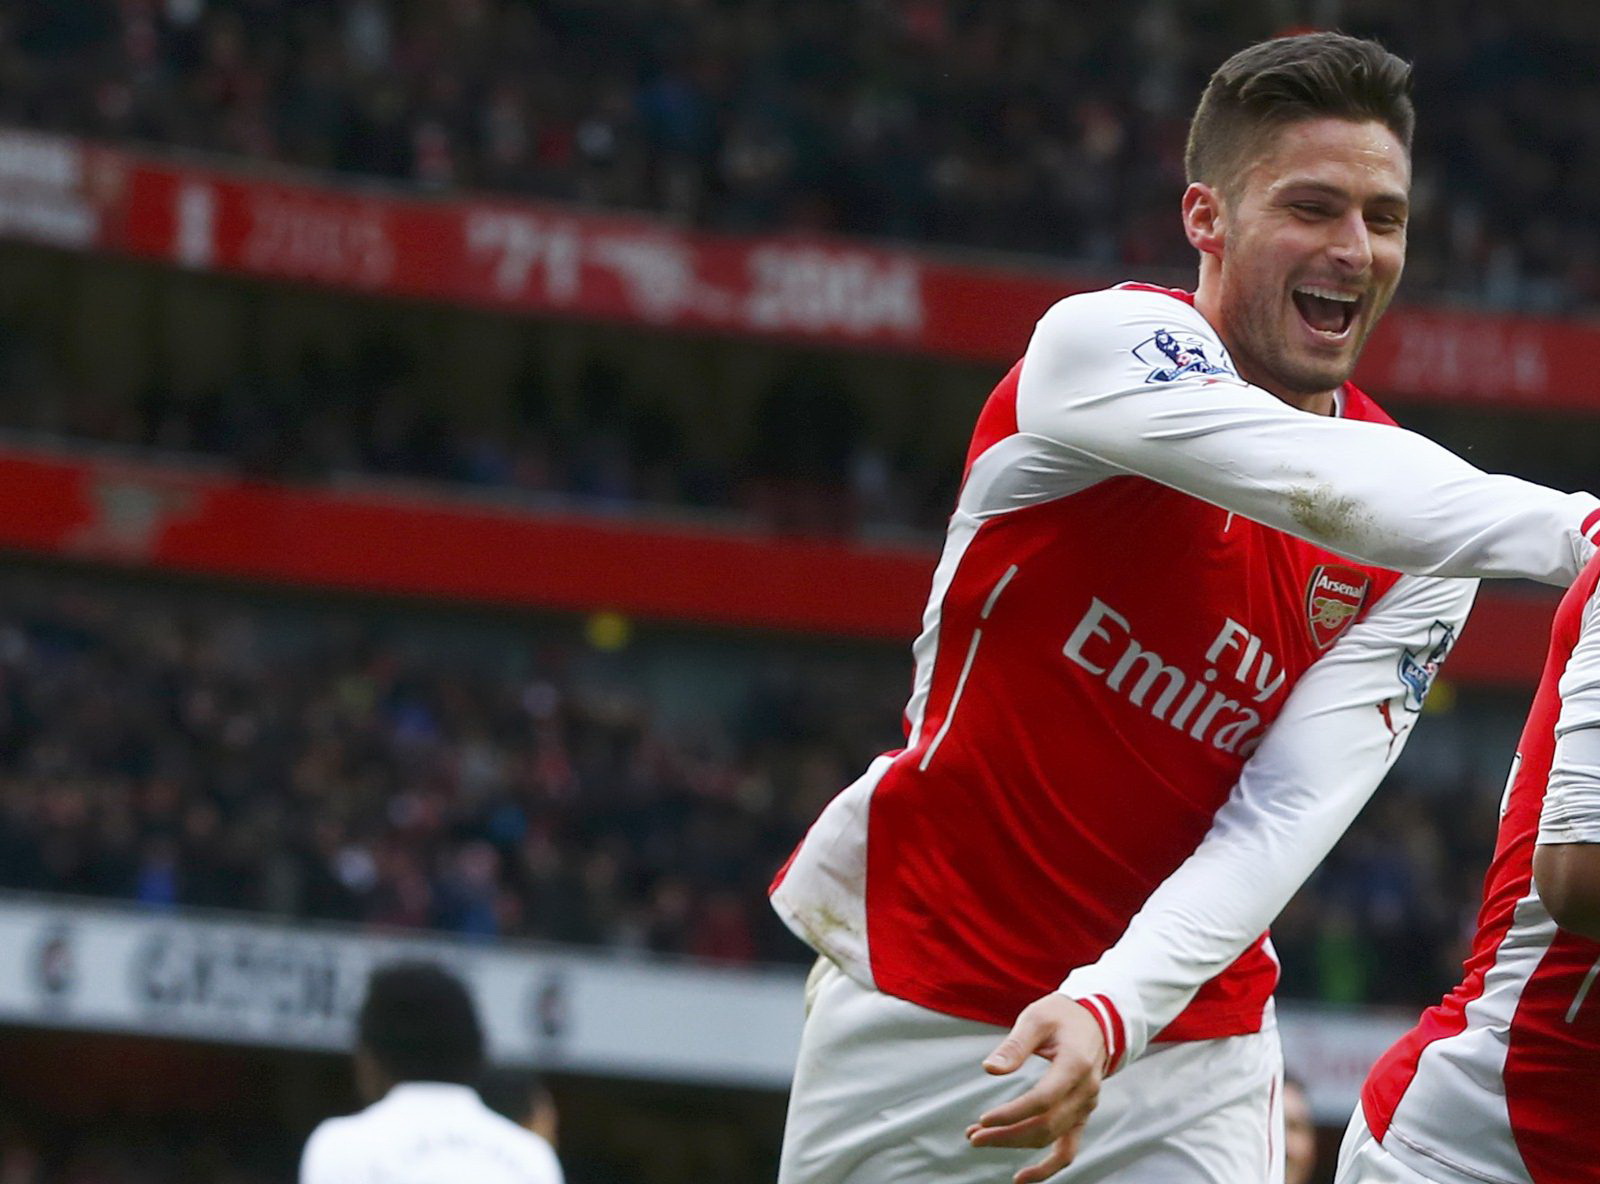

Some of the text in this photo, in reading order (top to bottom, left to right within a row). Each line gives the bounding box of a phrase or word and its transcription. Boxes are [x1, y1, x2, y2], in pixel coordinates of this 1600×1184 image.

[1317, 575, 1366, 598] Arsenal
[1062, 596, 1262, 757] Emira
[1205, 616, 1287, 702] Fly
